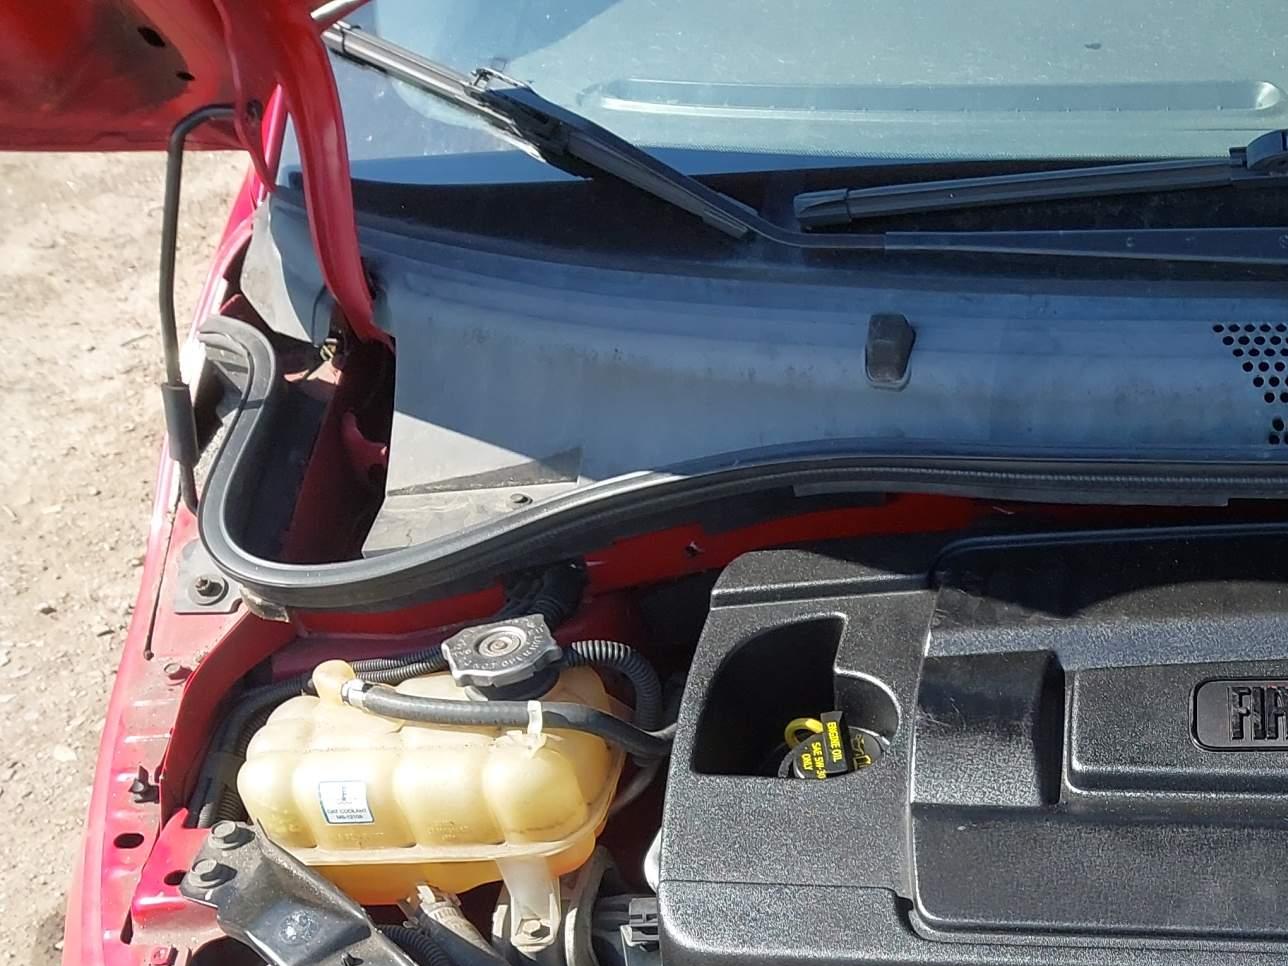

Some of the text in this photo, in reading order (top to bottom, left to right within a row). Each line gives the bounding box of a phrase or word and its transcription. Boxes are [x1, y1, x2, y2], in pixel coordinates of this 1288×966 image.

[812, 742, 826, 779] SAE 5W-30
[827, 721, 843, 763] ENGINE OIL
[802, 753, 813, 771] ONLY
